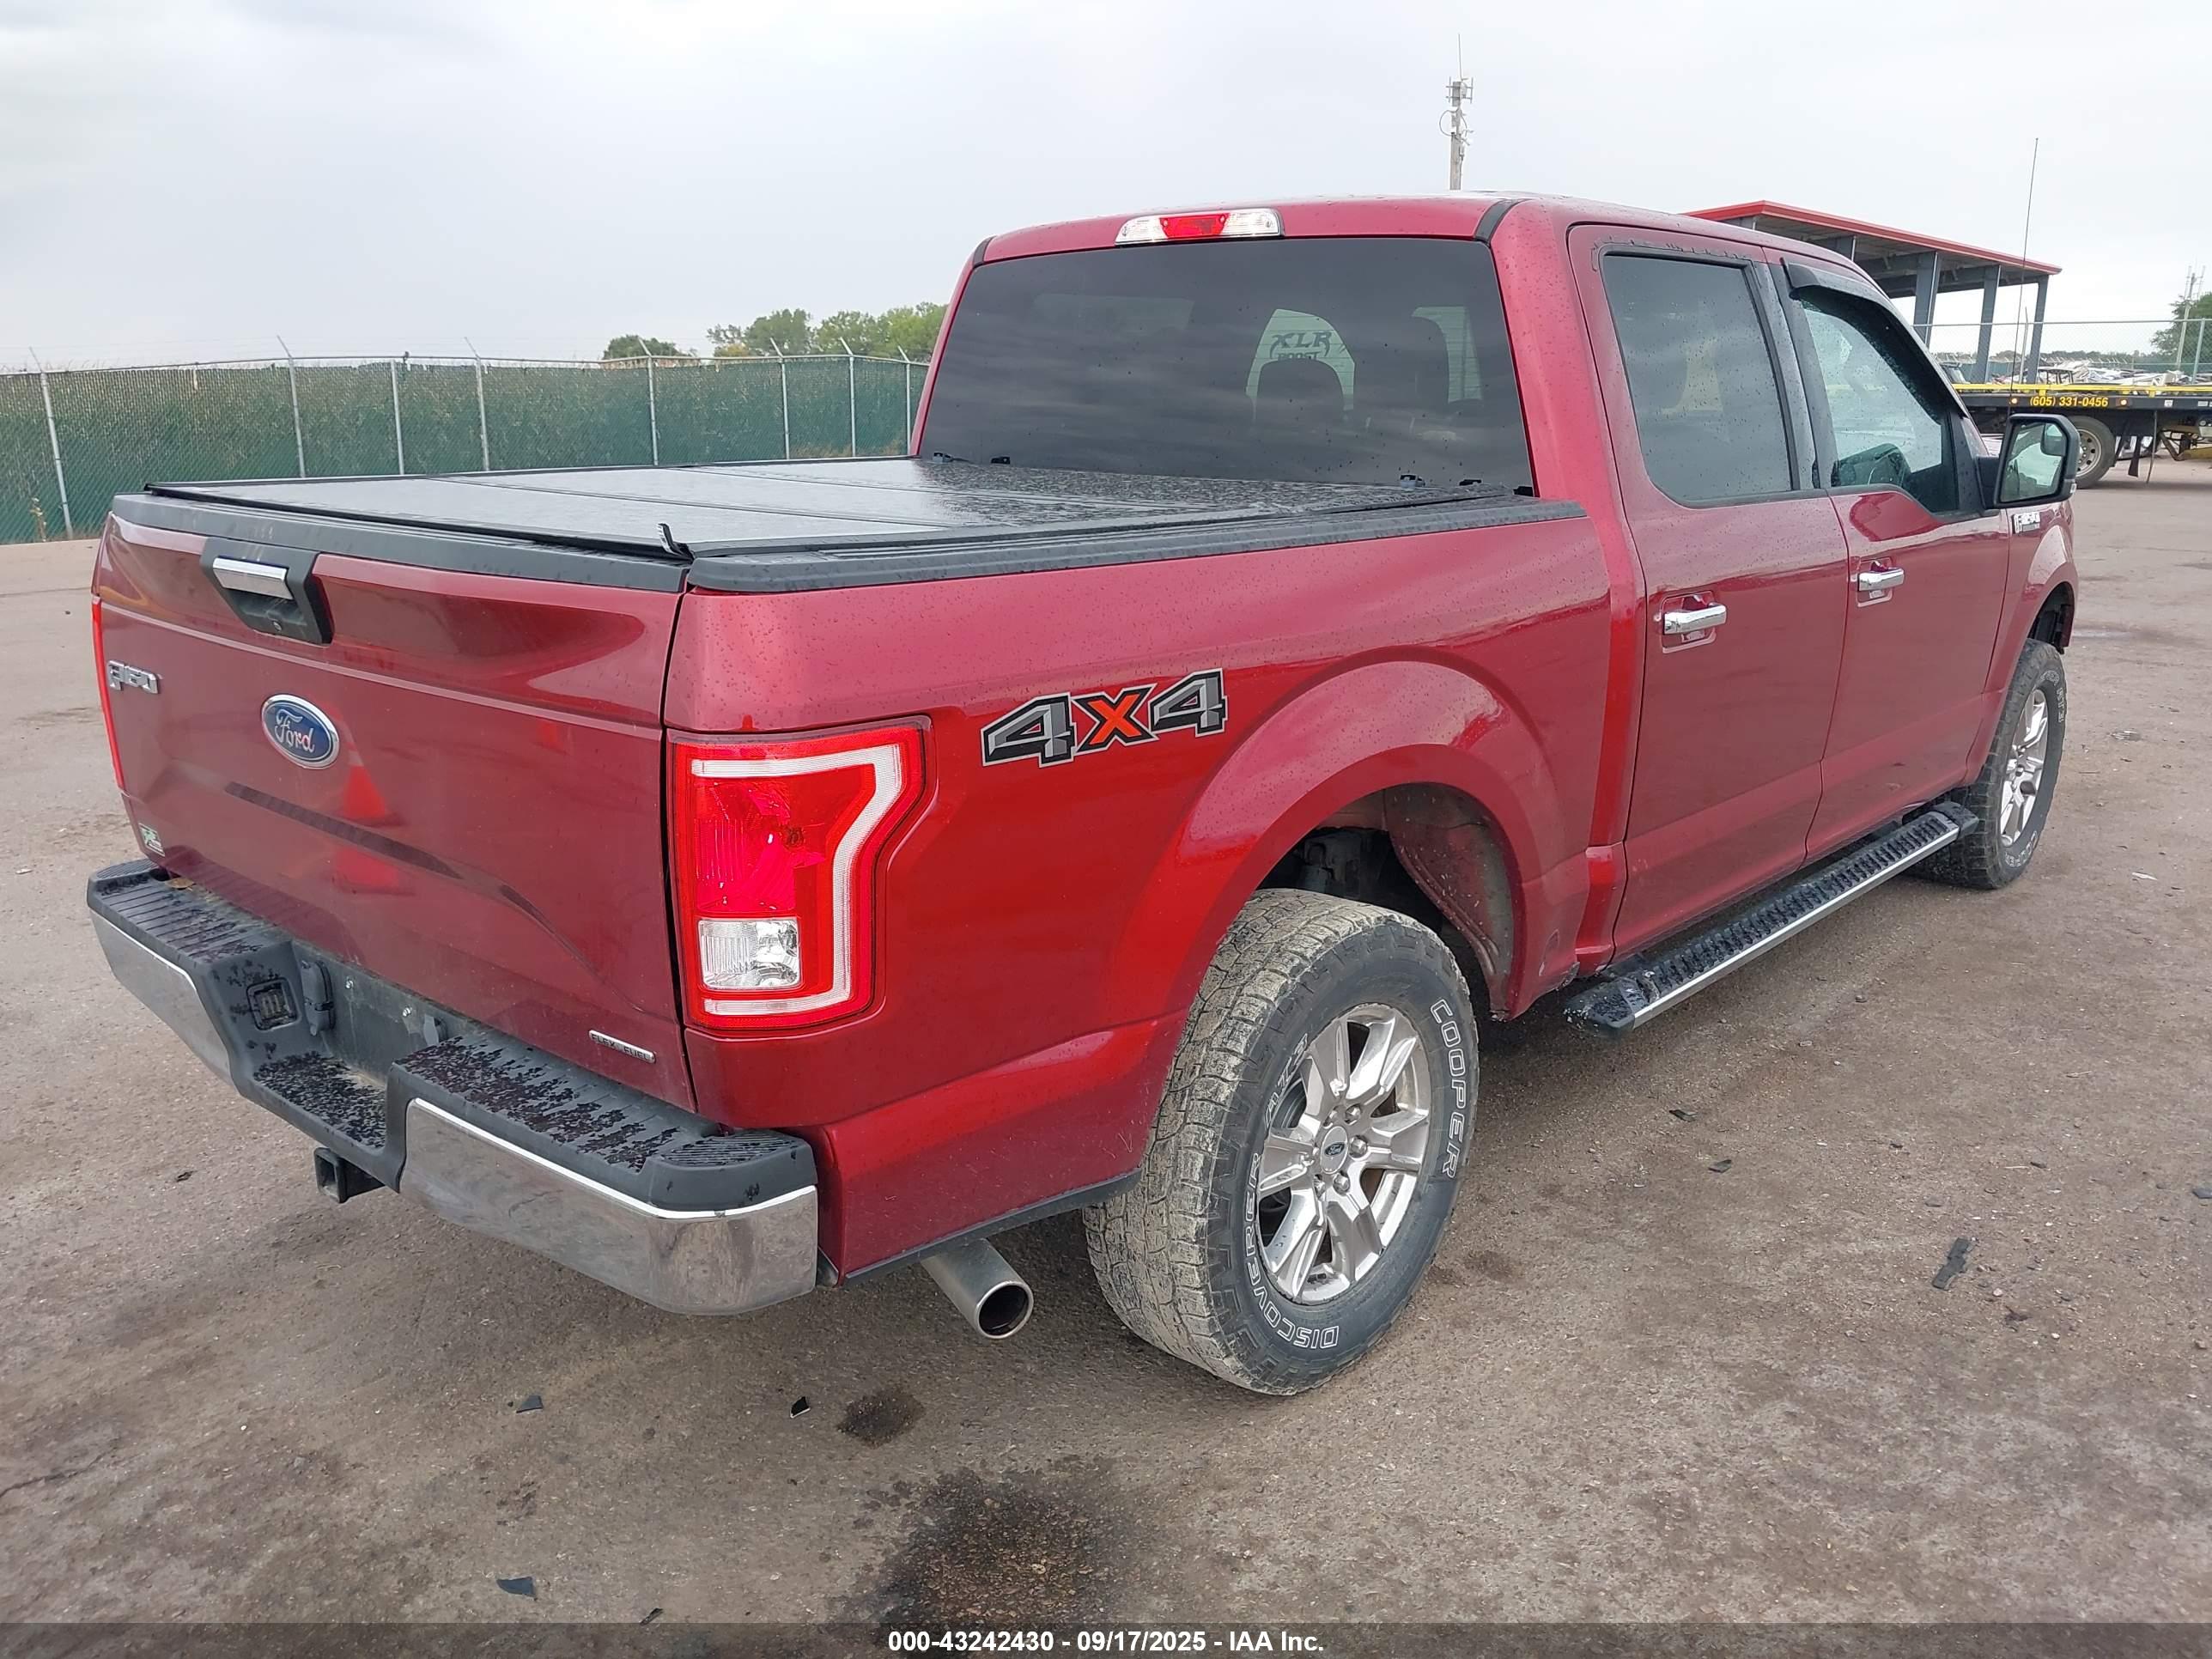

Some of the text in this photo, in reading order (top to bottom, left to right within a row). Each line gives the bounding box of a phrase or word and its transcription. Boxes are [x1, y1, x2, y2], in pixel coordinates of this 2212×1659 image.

[2030, 396, 2109, 407] (605) 331-0456
[274, 708, 315, 753] Ford
[591, 1033, 653, 1061] FLEX FUEL
[1429, 999, 1468, 1180] COOPER
[1245, 1152, 1340, 1348] DISCOVERER
